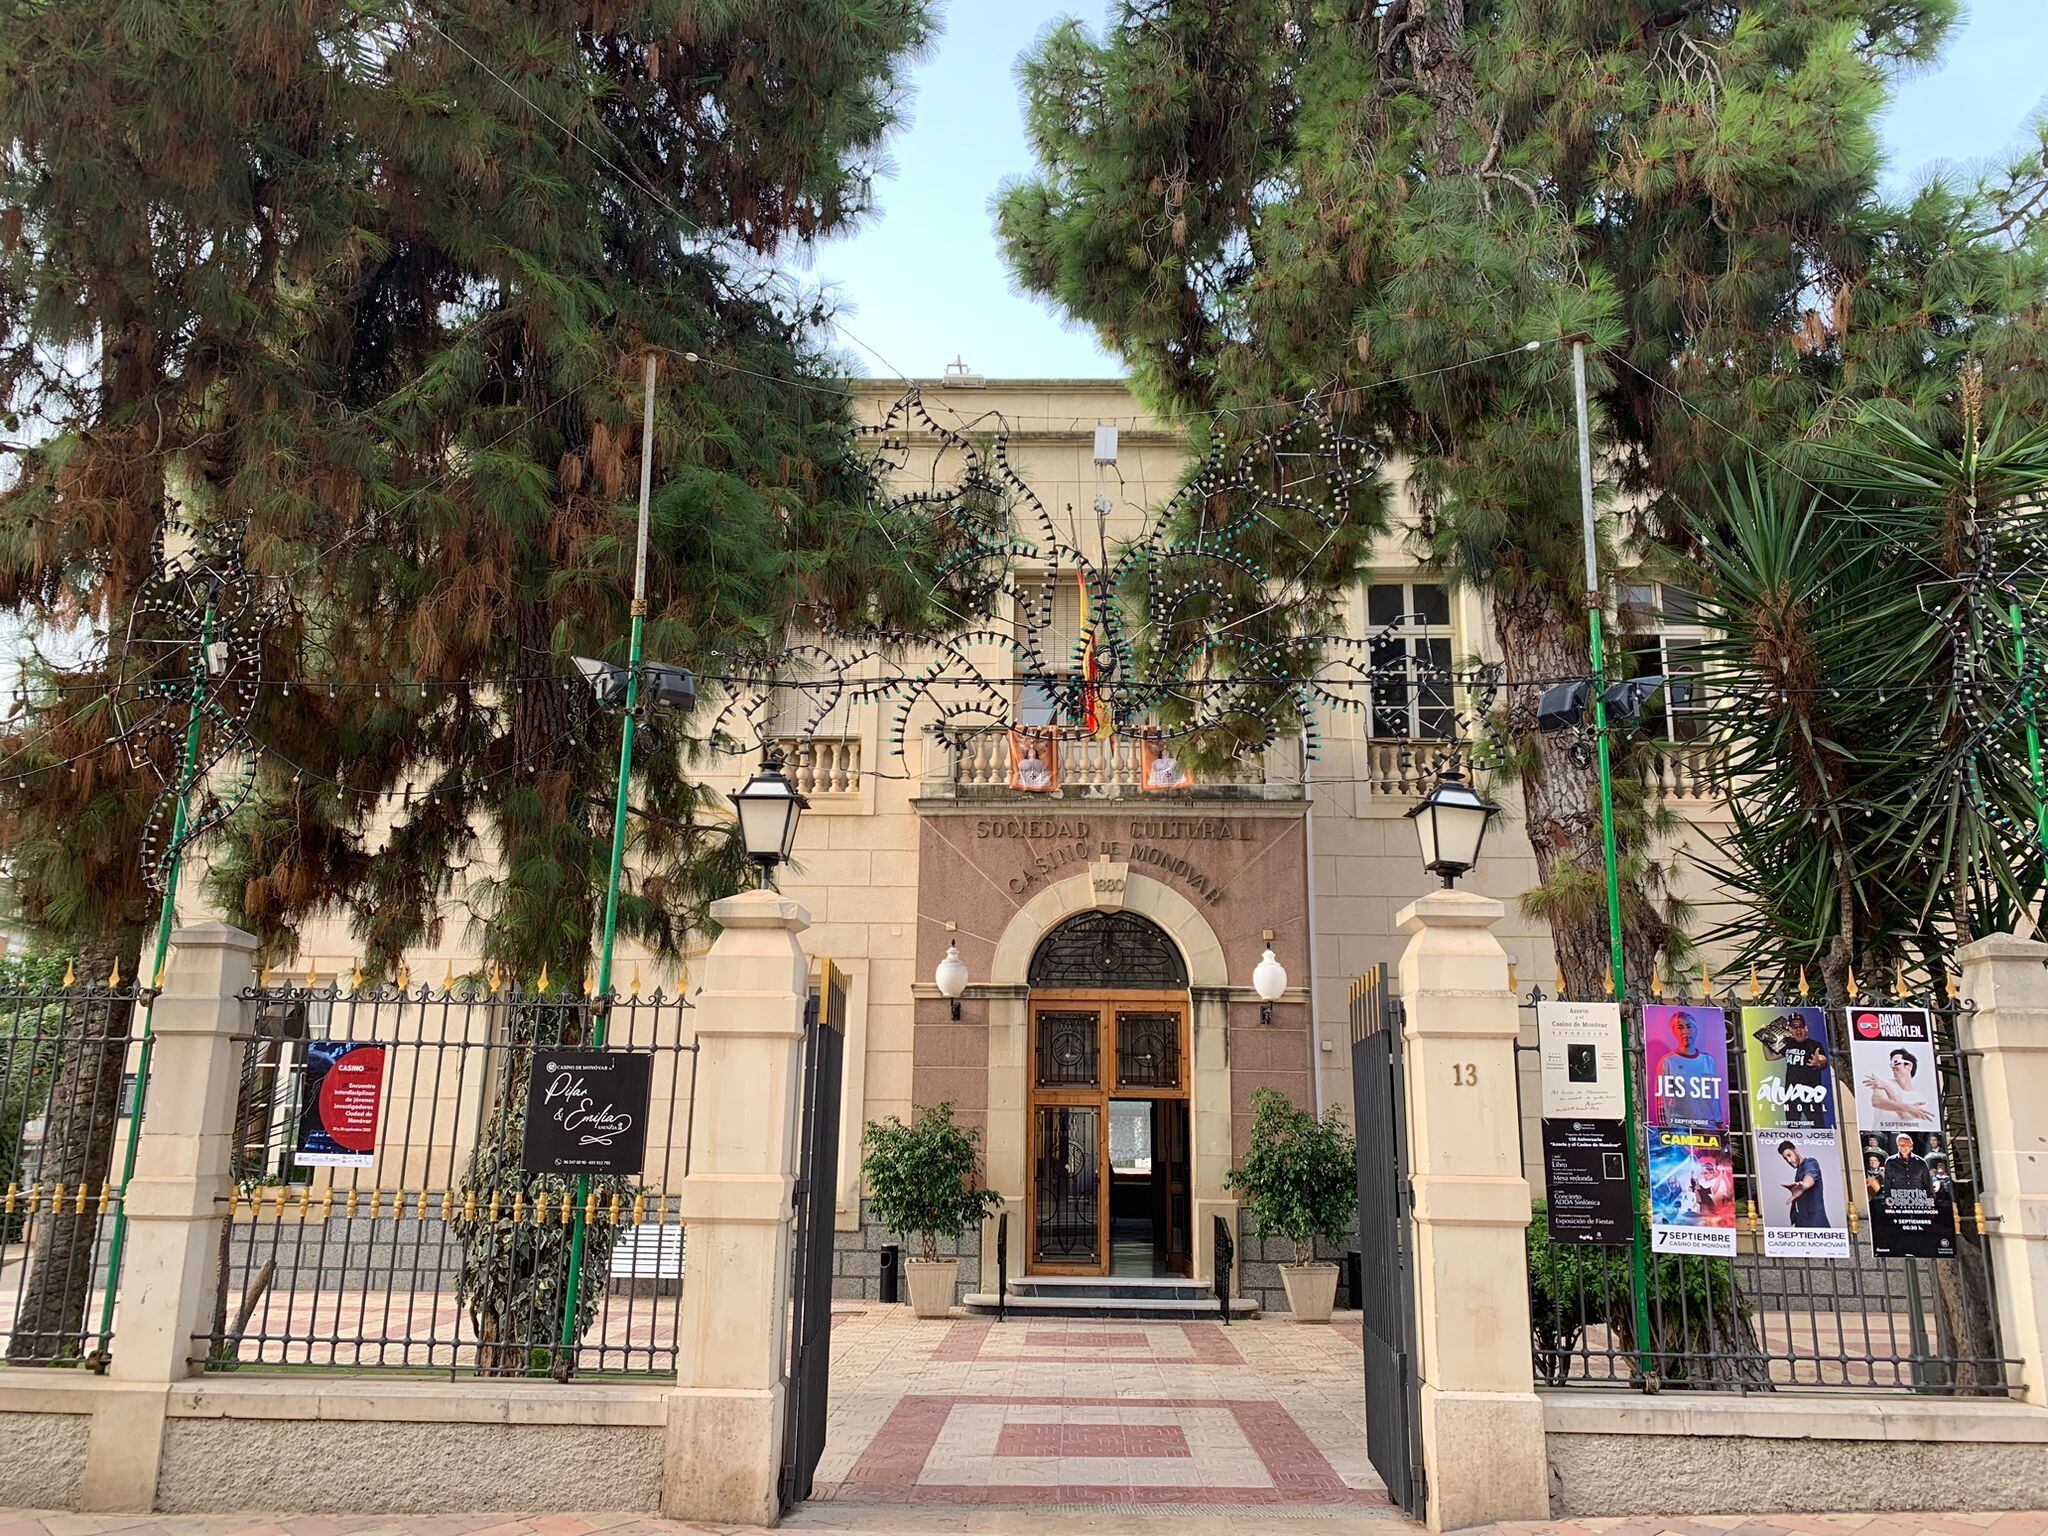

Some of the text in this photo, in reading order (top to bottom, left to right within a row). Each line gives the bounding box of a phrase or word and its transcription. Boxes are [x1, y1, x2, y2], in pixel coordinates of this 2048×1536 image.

[976, 820, 1253, 840] SOCIEDAD CULTURAL
[1007, 842, 1089, 895] CASINO
[1100, 841, 1120, 855] DE
[1878, 1013, 1903, 1026] DAVID
[1452, 1062, 1478, 1087] 13
[543, 1071, 588, 1106] Pilar
[1655, 1075, 1722, 1100] JES SET
[553, 1097, 631, 1131] & Emilia
[1759, 1103, 1828, 1112] FENOLL
[1661, 1134, 1719, 1147] CAMELA
[1759, 1130, 1834, 1139] ANTONIO JOSÉ
[1569, 1174, 1594, 1182] redonda
[1574, 1198, 1601, 1206] Sinfónica
[1885, 1196, 1935, 1207] OSBORNE
[1555, 1217, 1615, 1226] Exposición de Fiestas
[1658, 1231, 1731, 1245] 7 SEPTIEMBRE
[1767, 1230, 1846, 1240] 8 SEPTIEMBRE
[1797, 1240, 1807, 1248] DE
